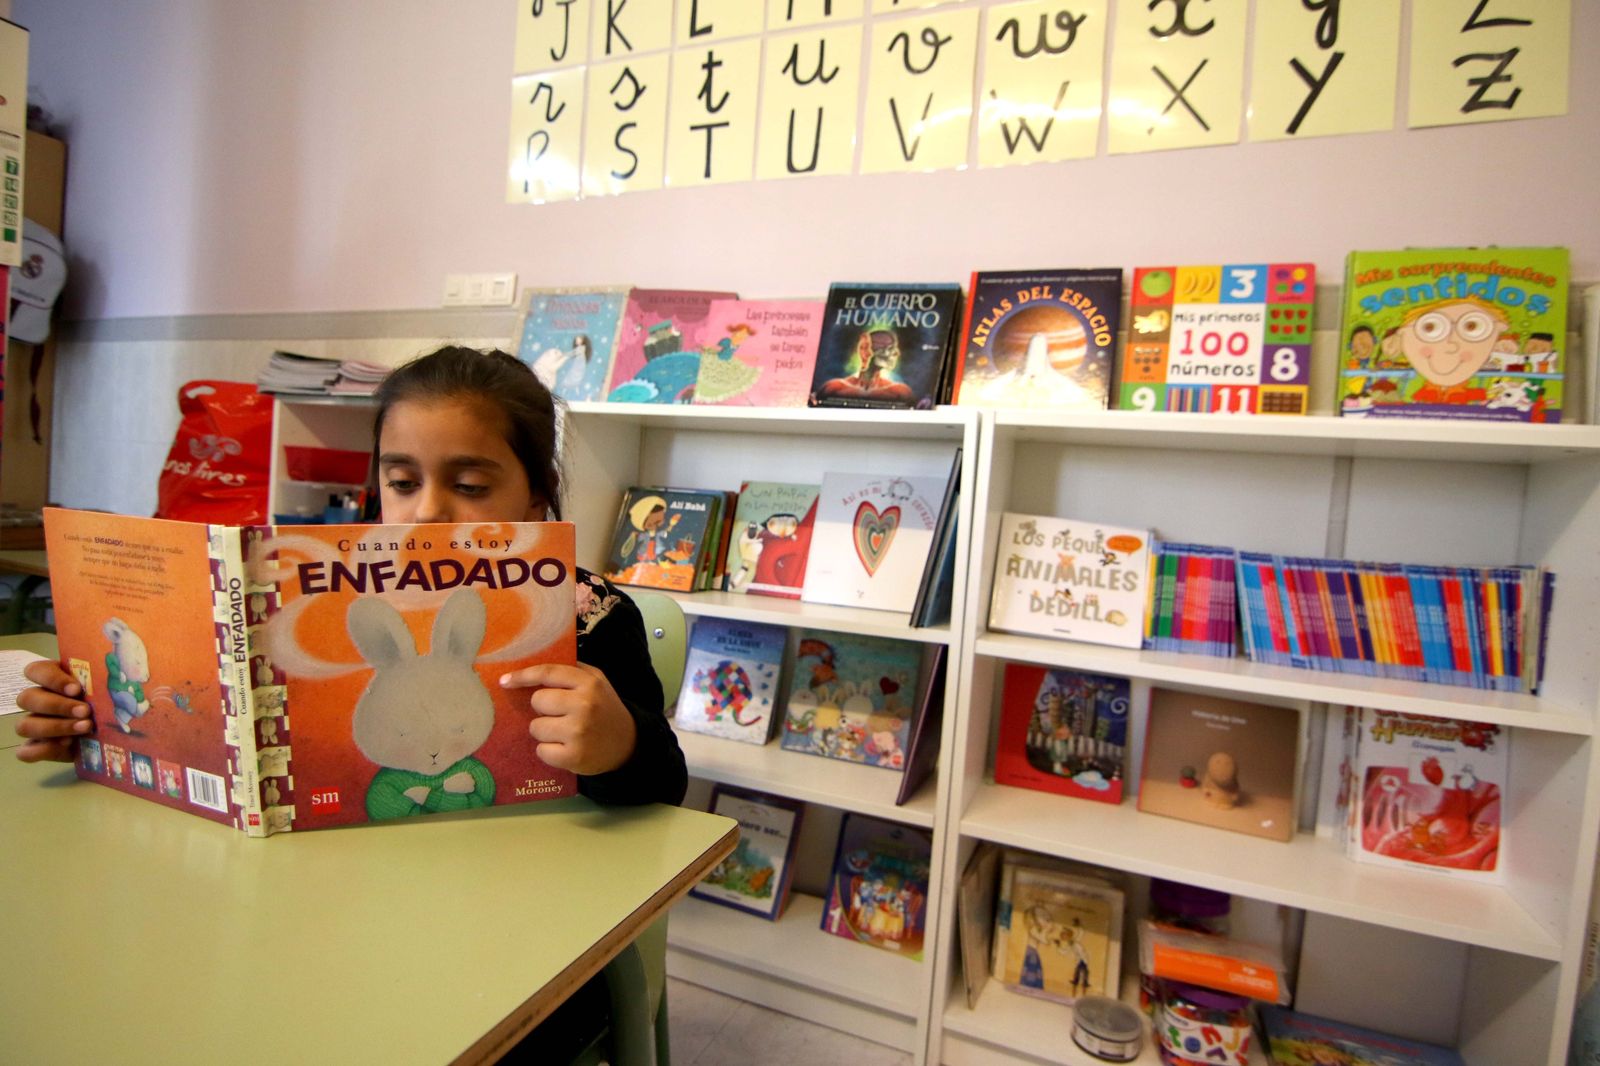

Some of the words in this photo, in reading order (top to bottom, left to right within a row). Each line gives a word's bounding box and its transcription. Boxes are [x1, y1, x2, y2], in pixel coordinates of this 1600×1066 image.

[605, 0, 632, 54] K
[689, 0, 713, 38] L
[610, 66, 647, 111] s
[697, 50, 730, 113] t
[782, 39, 839, 85] u
[887, 27, 953, 75] v
[995, 10, 1087, 58] w
[610, 122, 638, 179] S
[690, 121, 730, 178] T
[786, 106, 823, 173] U
[890, 92, 934, 161] V
[1147, 59, 1210, 136] X
[1452, 47, 1522, 114] Z
[1016, 285, 1054, 305] DEL
[1230, 269, 1257, 299] 3
[1360, 272, 1552, 315] sentidos
[844, 297, 858, 309] EL
[860, 292, 937, 311] CUERPO
[835, 309, 940, 329] HUMANO
[972, 298, 1014, 348] ATLAS
[1059, 288, 1113, 347] ESPACIO
[1174, 312, 1195, 323] Mis
[1198, 310, 1261, 326] primeros
[1180, 329, 1250, 357] 100
[1170, 359, 1257, 378] números
[1269, 347, 1300, 381] 8
[1131, 386, 1157, 412] 9
[1218, 388, 1252, 414] 11
[670, 501, 683, 510] Ali
[337, 538, 432, 552] Cuando
[450, 537, 514, 553] estoy
[1013, 531, 1046, 548] LOS
[298, 557, 567, 595] ENFADADO
[1006, 554, 1139, 592] ANIMALES
[229, 577, 247, 664] ENFADADO
[239, 687, 248, 715] Cuando
[515, 784, 564, 797] Moroney
[525, 779, 557, 787] Trace
[312, 790, 339, 805] sm
